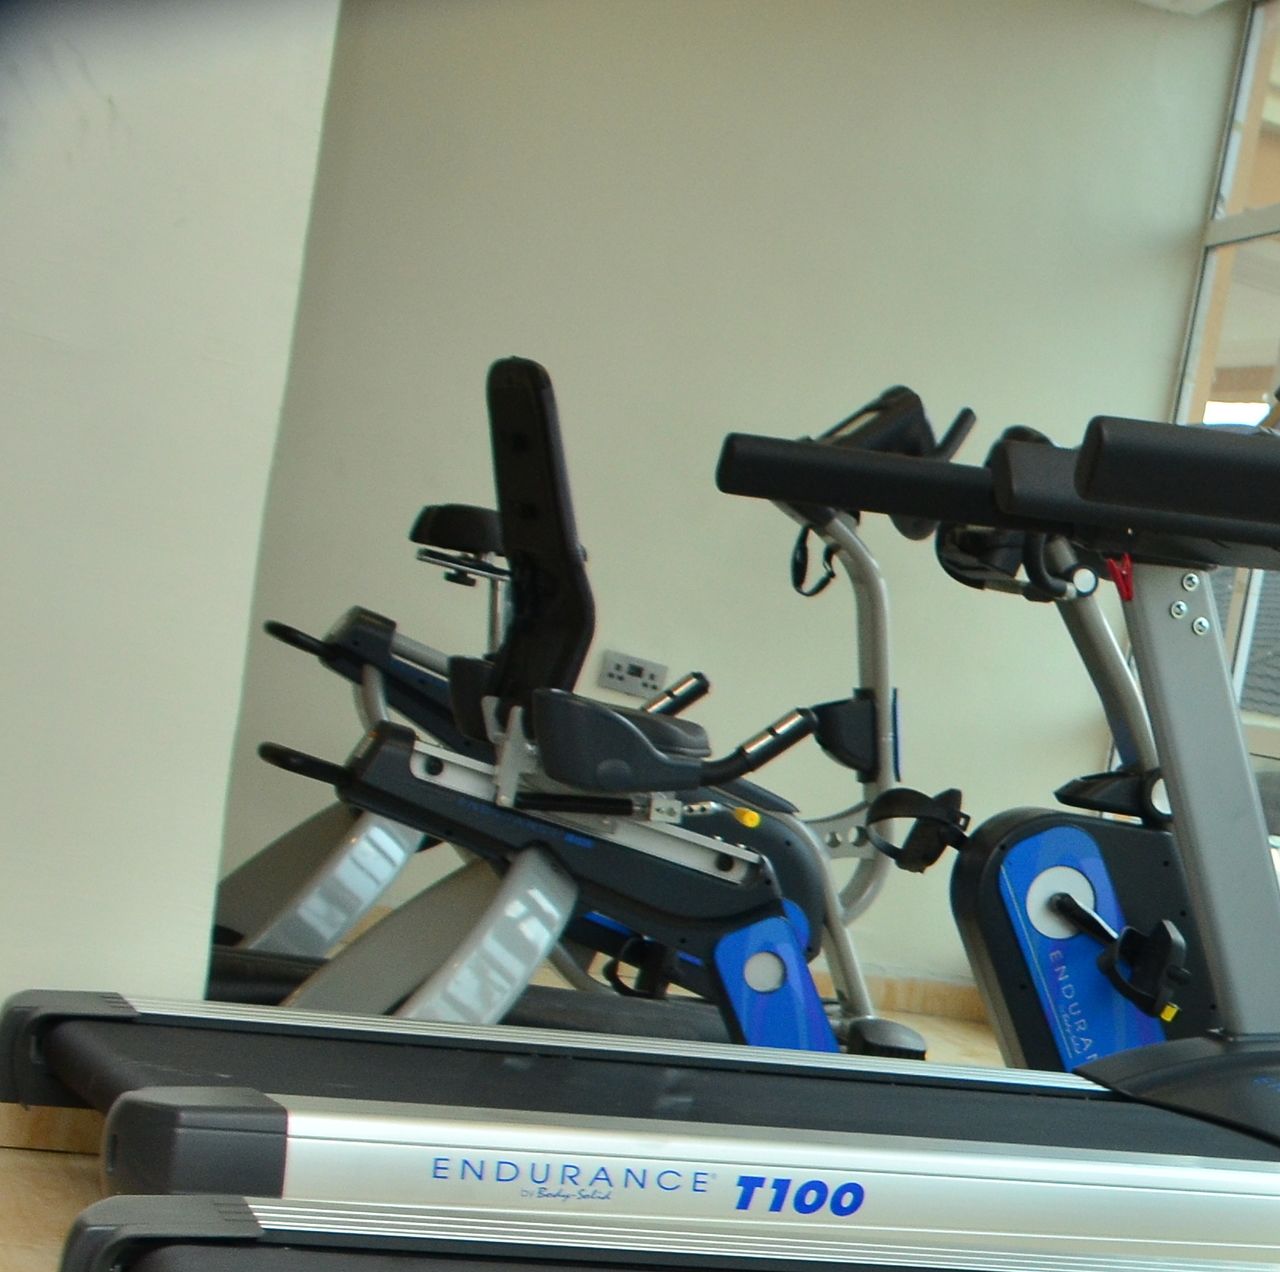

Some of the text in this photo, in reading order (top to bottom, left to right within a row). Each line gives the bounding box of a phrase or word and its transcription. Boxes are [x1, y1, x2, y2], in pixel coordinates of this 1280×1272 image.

[432, 1157, 866, 1217] ENDURANCE T100
[535, 1187, 612, 1201] Body-Solid
